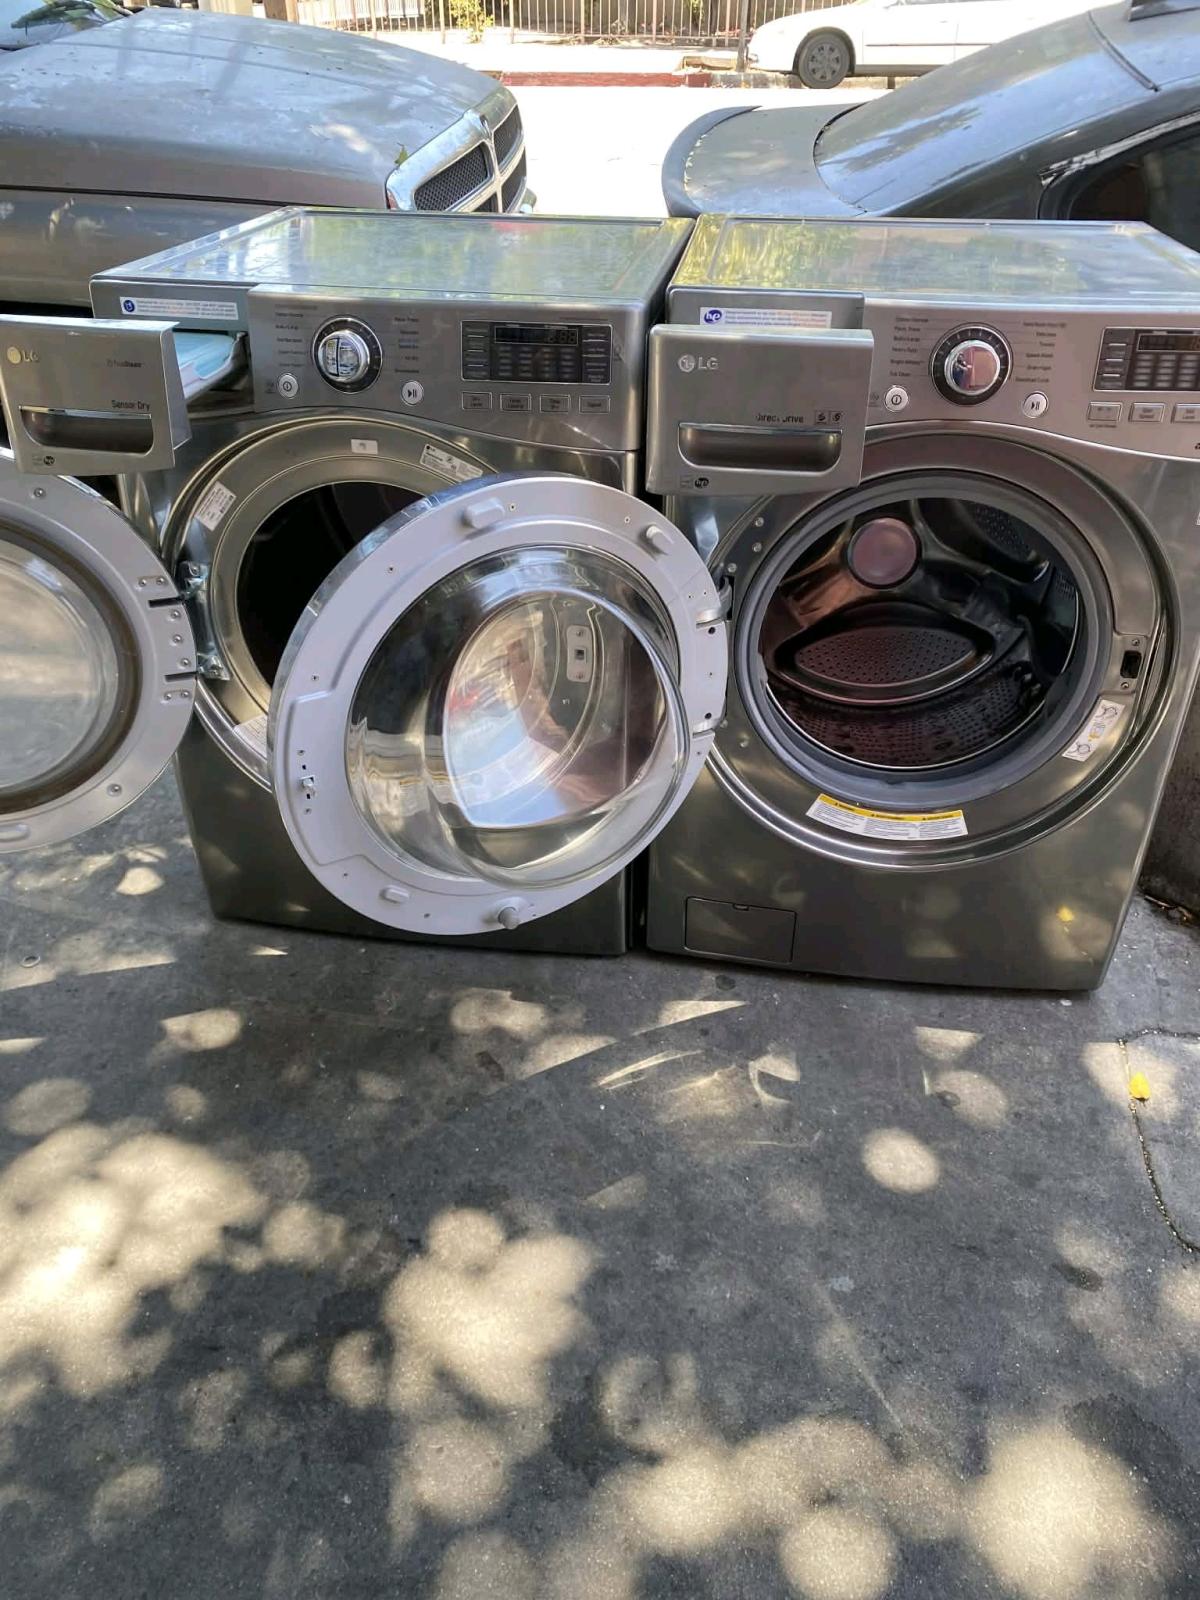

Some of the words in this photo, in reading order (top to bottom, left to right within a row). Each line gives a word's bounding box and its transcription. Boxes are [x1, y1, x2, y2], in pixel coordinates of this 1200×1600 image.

[698, 357, 719, 370] LG
[111, 400, 137, 409] Sensor
[138, 401, 151, 411] Dry
